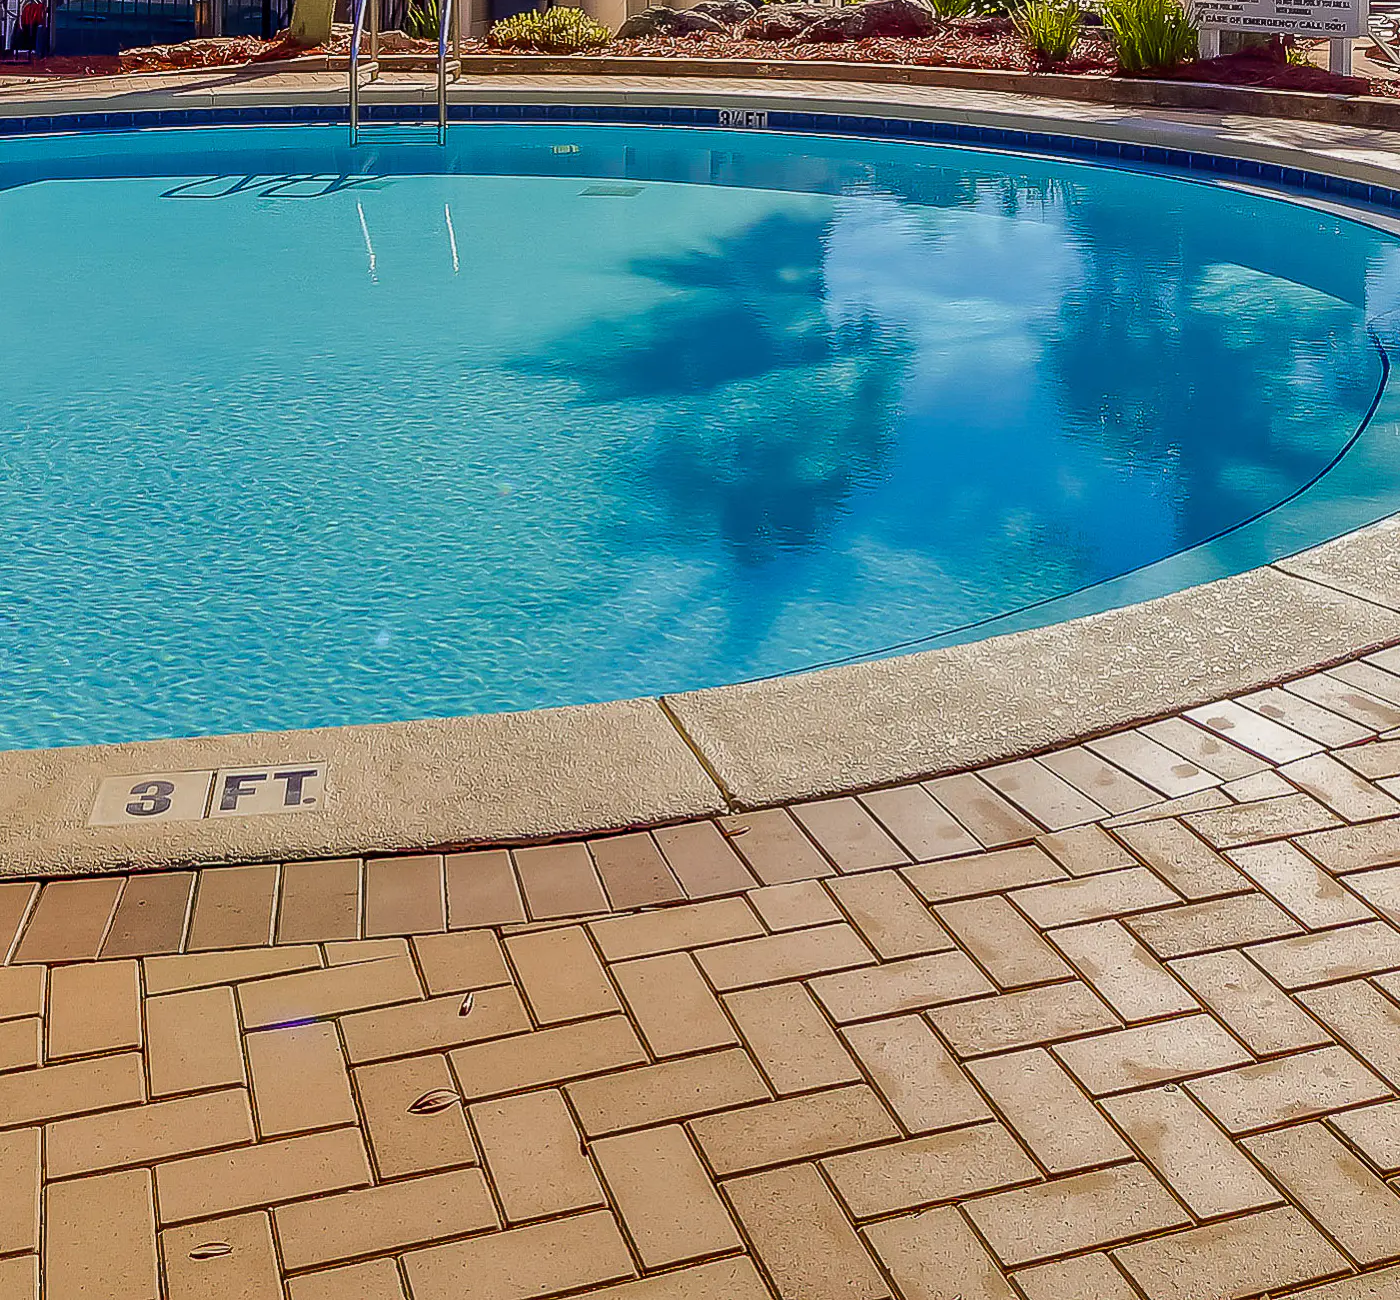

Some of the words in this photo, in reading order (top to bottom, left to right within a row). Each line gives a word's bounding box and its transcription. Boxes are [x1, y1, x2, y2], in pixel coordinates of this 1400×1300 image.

[1206, 14, 1228, 24] CASE
[1229, 16, 1241, 25] OF
[1242, 17, 1297, 29] EMERGENCY
[1299, 20, 1323, 30] CALL
[1325, 22, 1346, 32] 5001
[125, 780, 175, 816] 3
[219, 769, 318, 811] FT.
